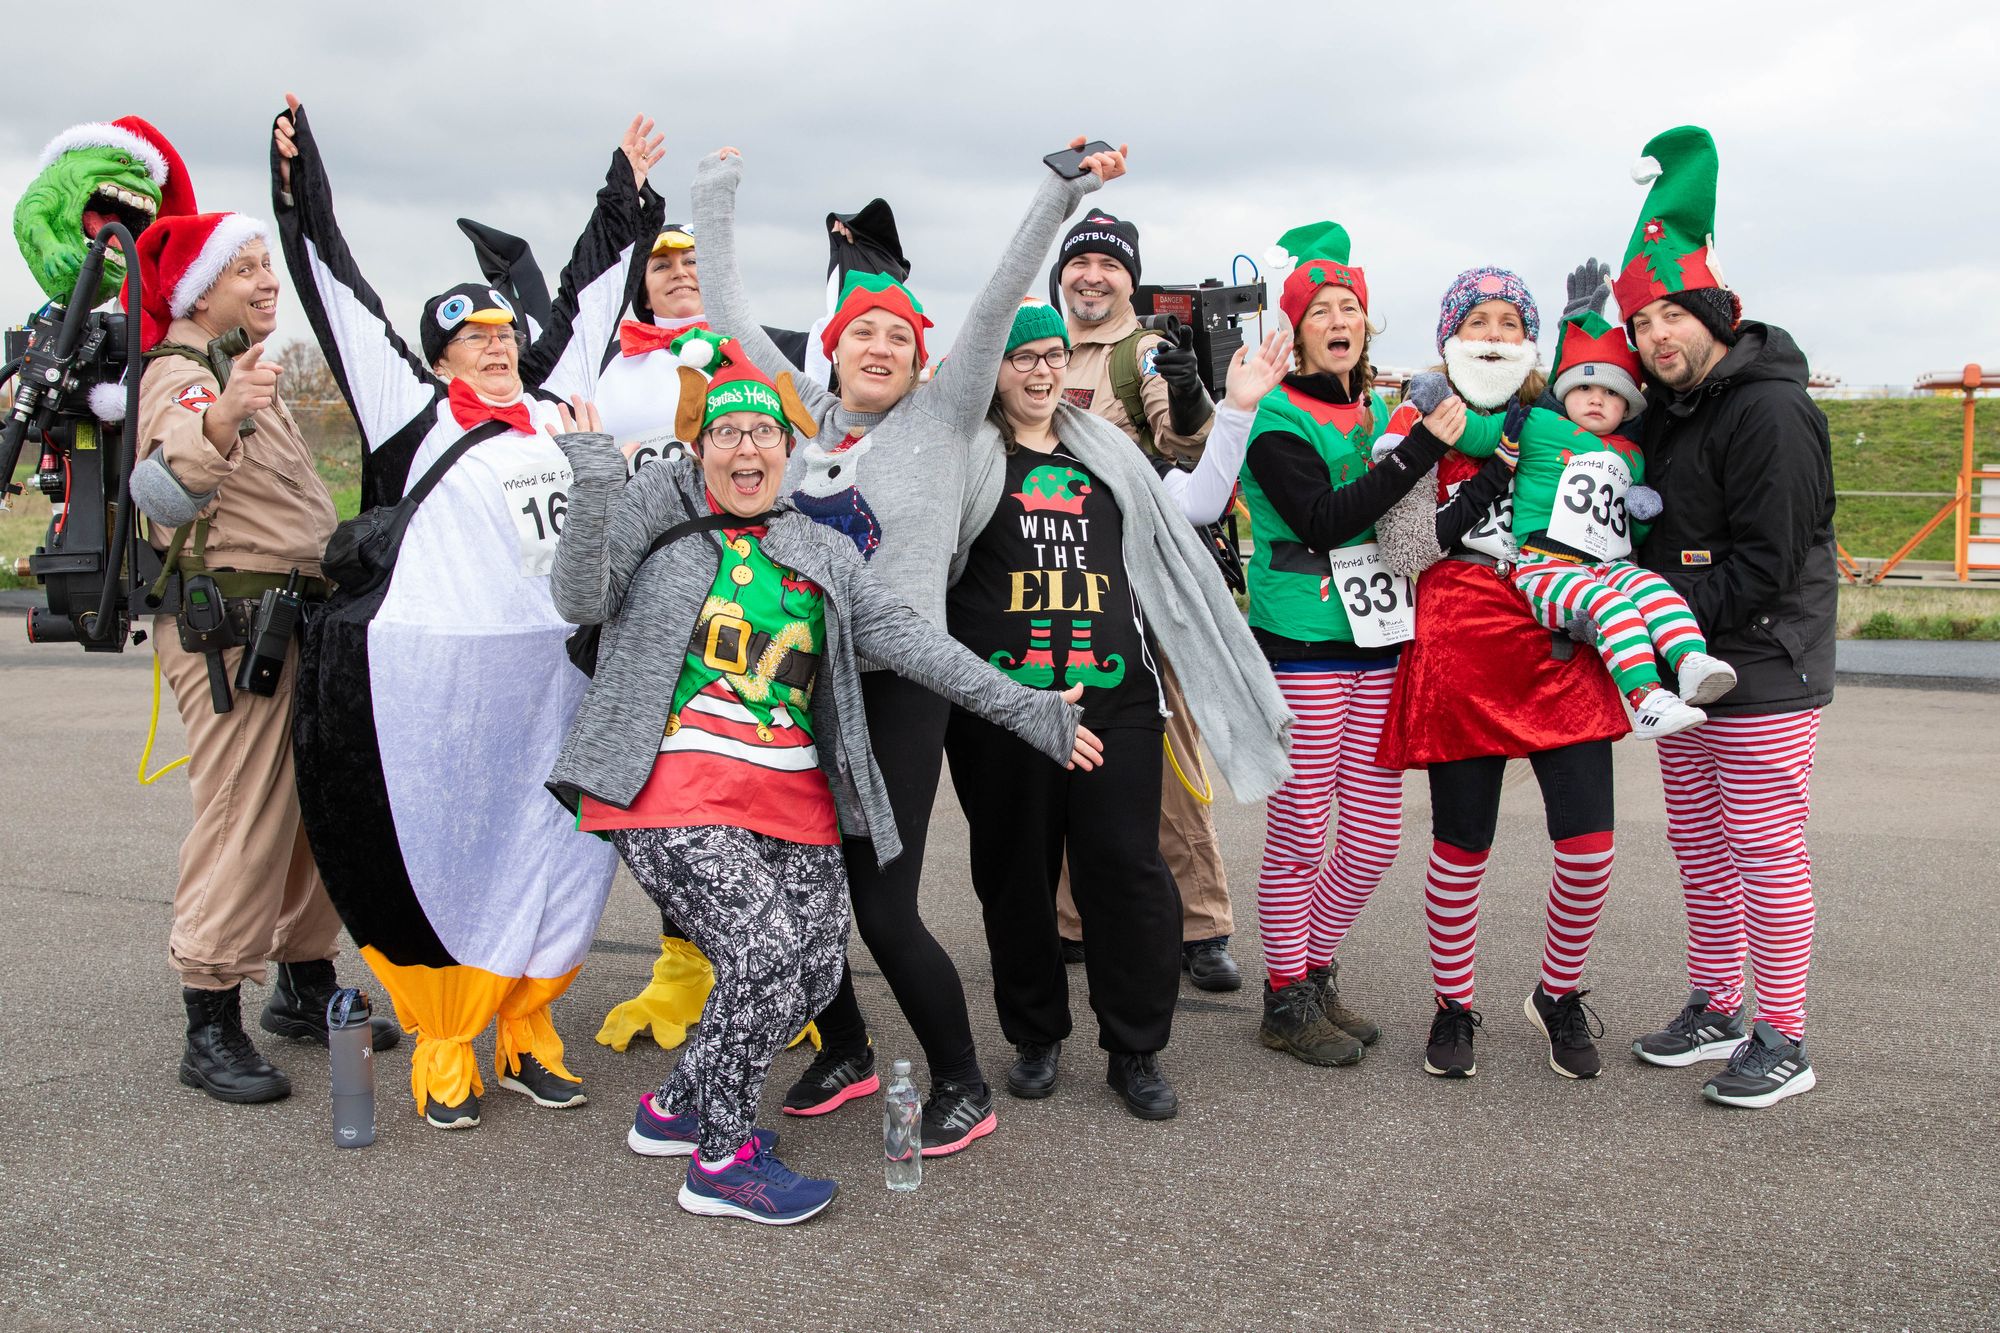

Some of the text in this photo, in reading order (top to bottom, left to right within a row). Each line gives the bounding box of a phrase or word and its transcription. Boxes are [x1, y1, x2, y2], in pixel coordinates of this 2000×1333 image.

[1064, 231, 1135, 258] GHOSTBUSTERS
[1160, 296, 1184, 304] DANGER
[707, 387, 743, 413] Santa's
[503, 475, 539, 491] Mental
[541, 471, 557, 483] Elf
[1568, 460, 1605, 469] Mental
[1607, 464, 1619, 477] Elf
[1563, 473, 1627, 538] 333
[1019, 515, 1089, 542] WHAT
[1033, 543, 1087, 570] THE
[1332, 553, 1380, 570] Mental Elf
[1003, 569, 1111, 614] ELF
